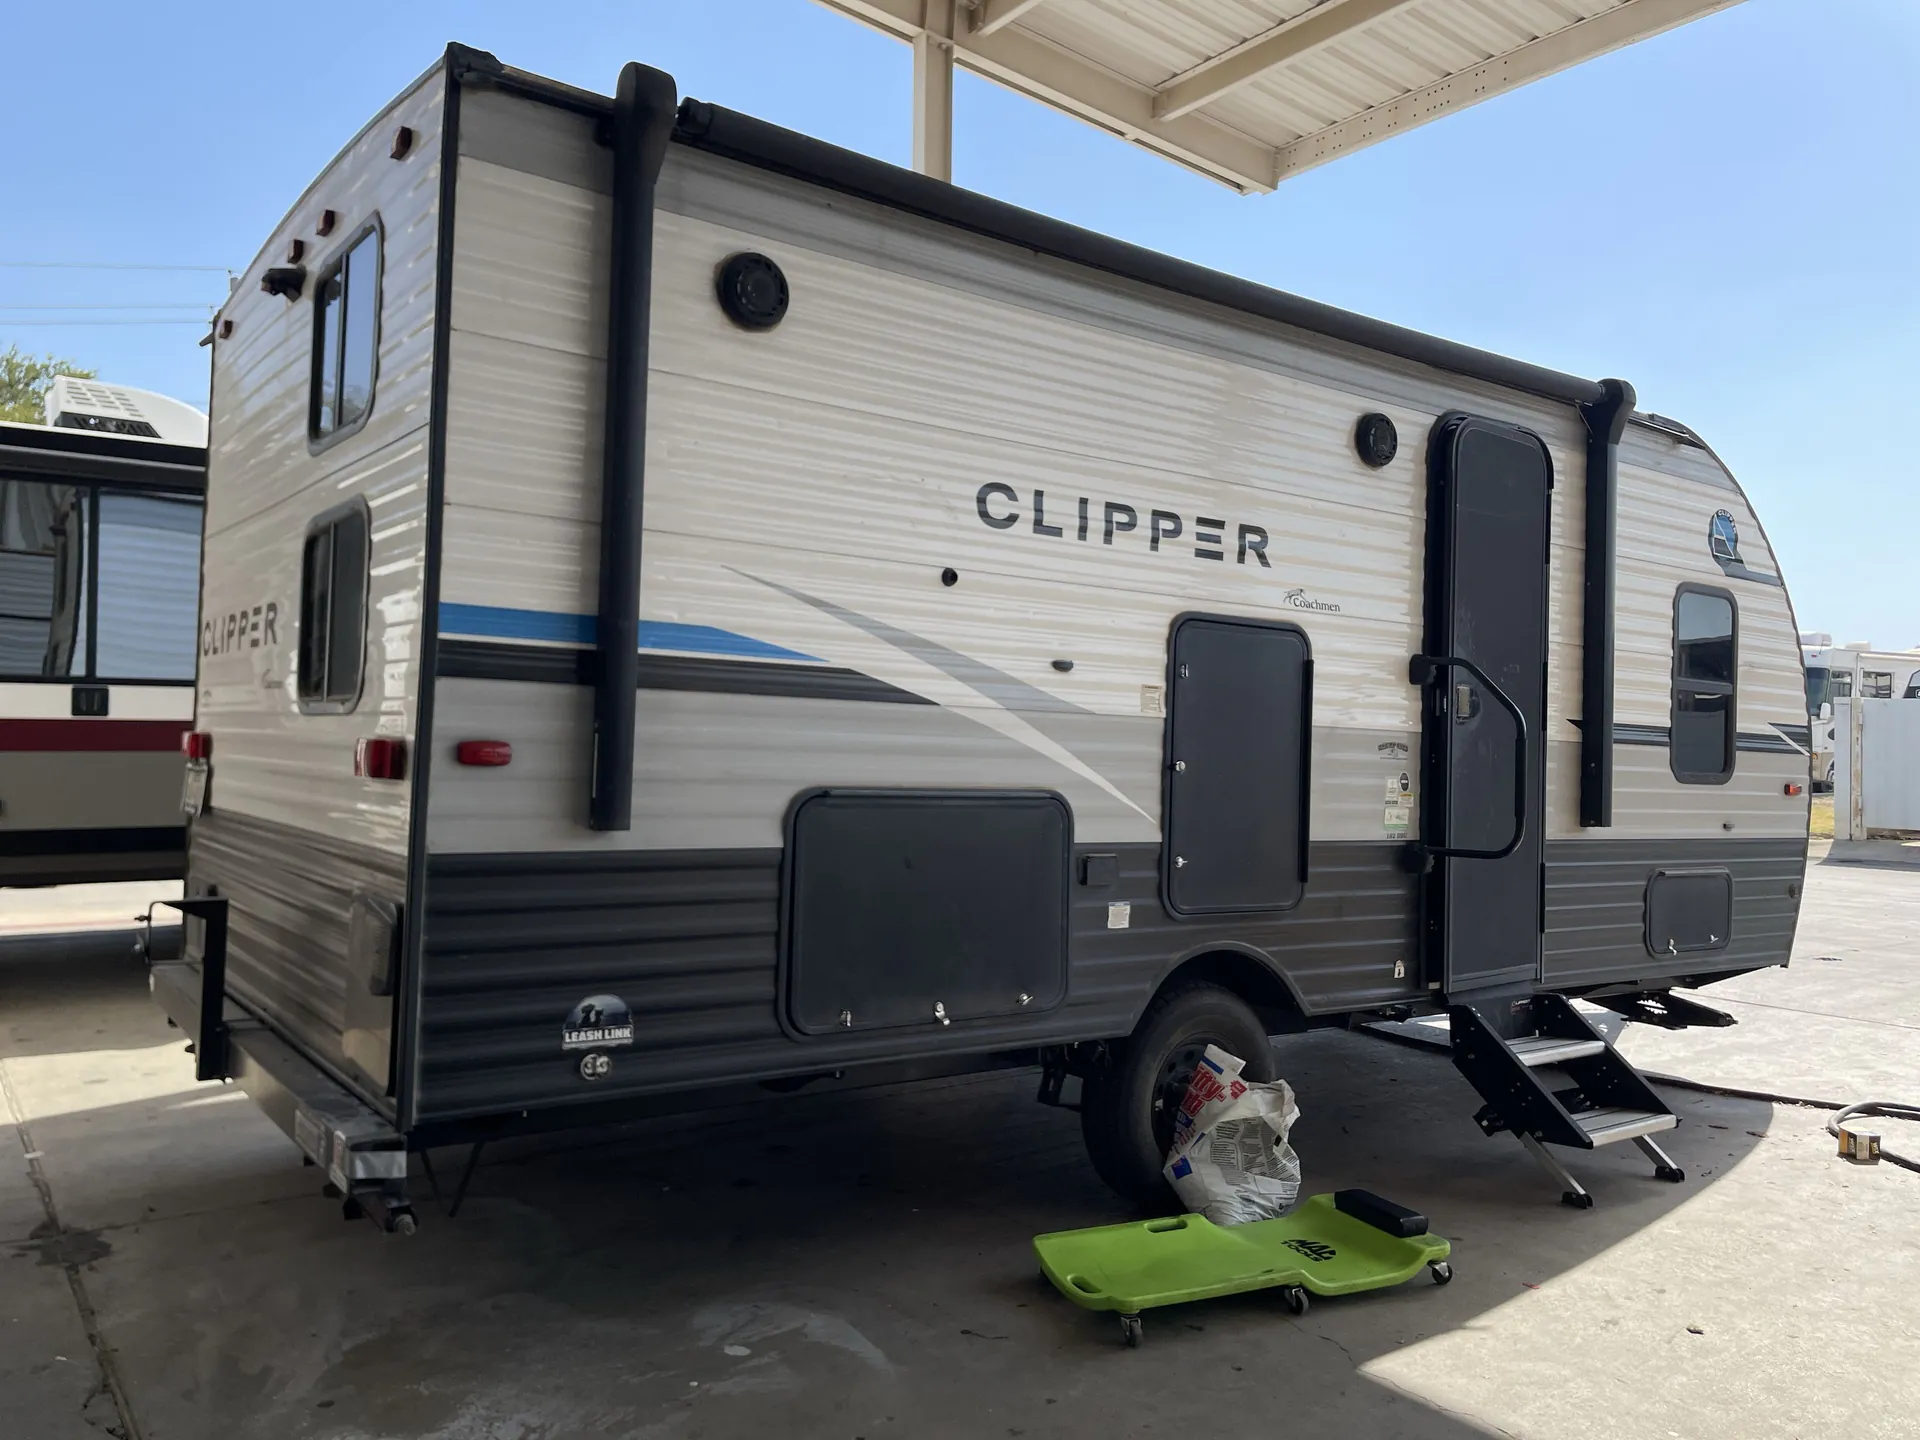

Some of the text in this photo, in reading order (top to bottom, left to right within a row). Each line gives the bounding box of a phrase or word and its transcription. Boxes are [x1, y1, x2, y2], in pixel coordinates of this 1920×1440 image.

[976, 482, 1272, 569] CLIPPER
[1293, 597, 1341, 612] Coachmen
[203, 602, 278, 656] CLIPPER
[565, 1027, 631, 1043] LEASH LINK
[1280, 1240, 1324, 1262] TOOLS
[1286, 1239, 1336, 1260] MAC
